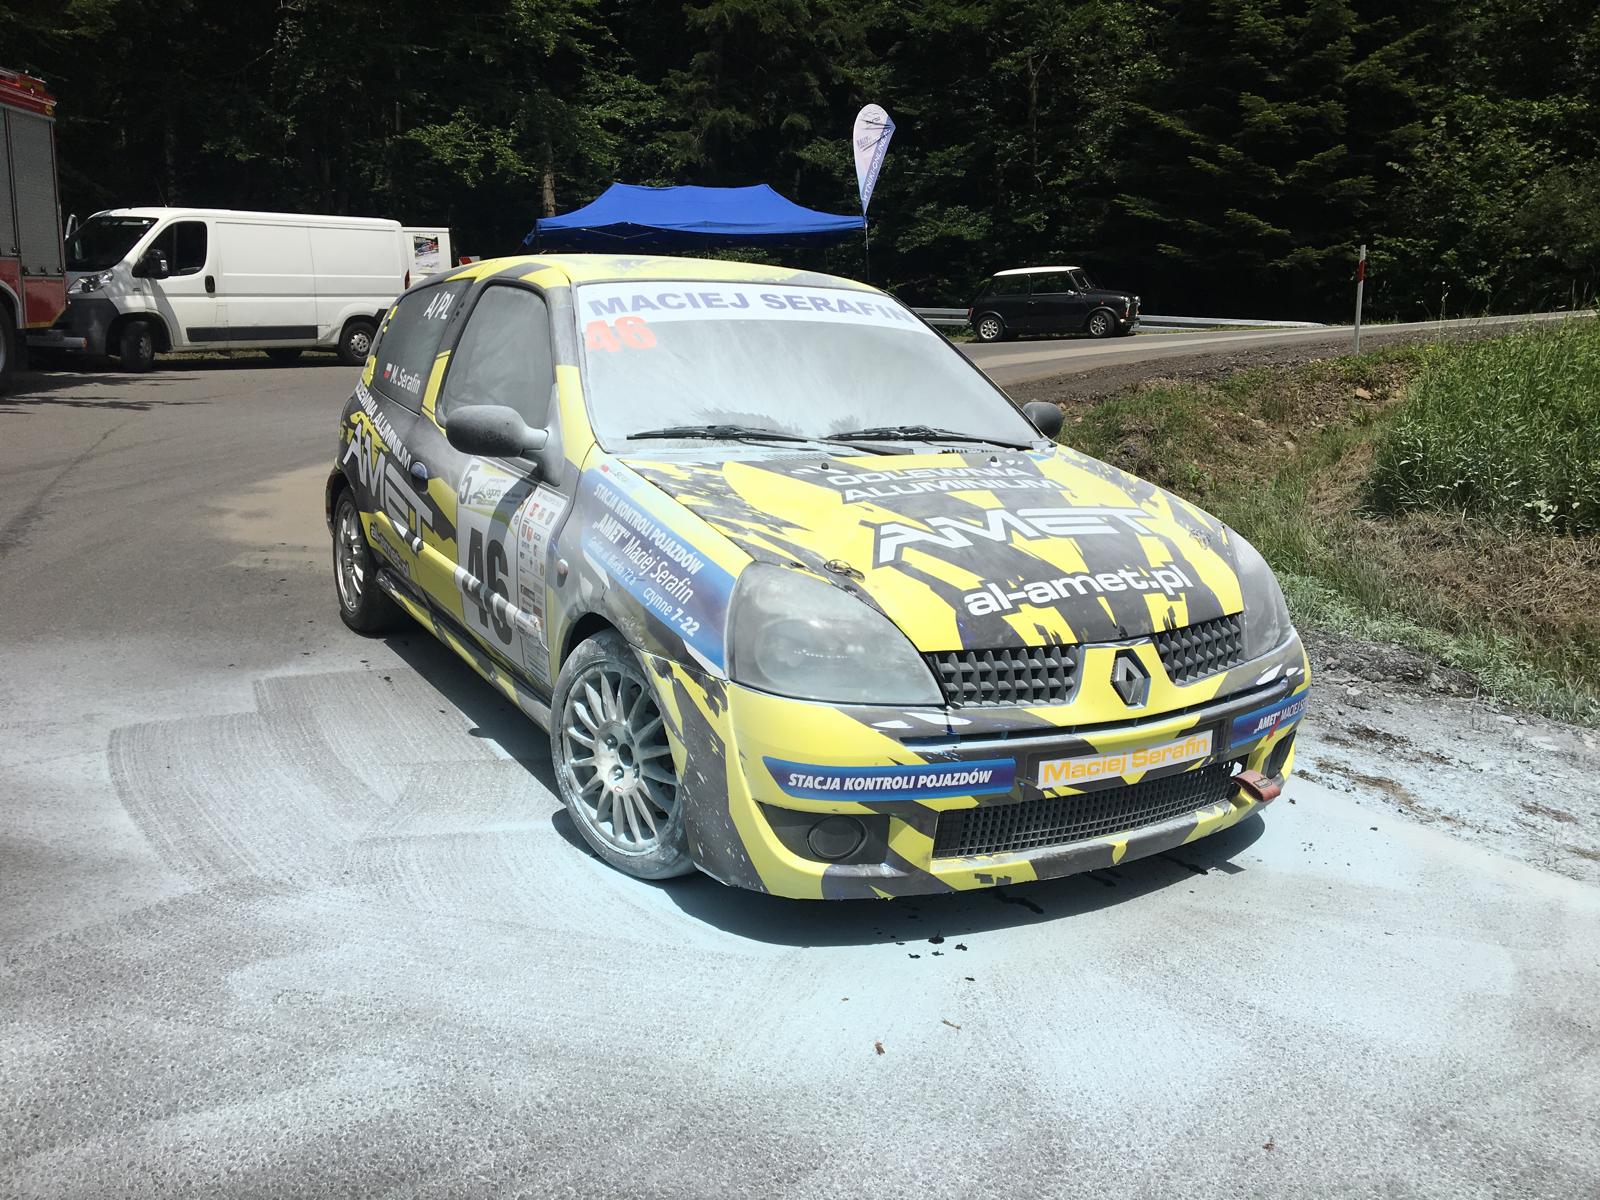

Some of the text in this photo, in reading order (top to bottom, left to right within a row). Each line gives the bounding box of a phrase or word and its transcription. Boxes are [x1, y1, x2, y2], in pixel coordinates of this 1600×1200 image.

[423, 291, 455, 320] A/PL
[588, 293, 916, 323] MACIEJ SERAFIN
[585, 316, 657, 352] 46
[397, 368, 421, 394] Serafin
[343, 422, 433, 540] AMET
[826, 467, 1036, 486] ODLEWNIA
[844, 478, 1066, 503] ALUMINIUM
[593, 483, 620, 509] STACJA
[614, 498, 655, 539] KONTROLI
[649, 527, 705, 576] POJAZDÓW
[879, 507, 1155, 564] AMET
[467, 527, 513, 646] 46
[622, 536, 660, 577] Maciej
[649, 560, 695, 605] Serafin
[963, 565, 1194, 616] al-amet.pl
[642, 587, 700, 637] czynne 7-22
[788, 767, 993, 791] STACJA KONTROLI POJAZDÓW
[1043, 736, 1208, 785] Maciej Serafin
